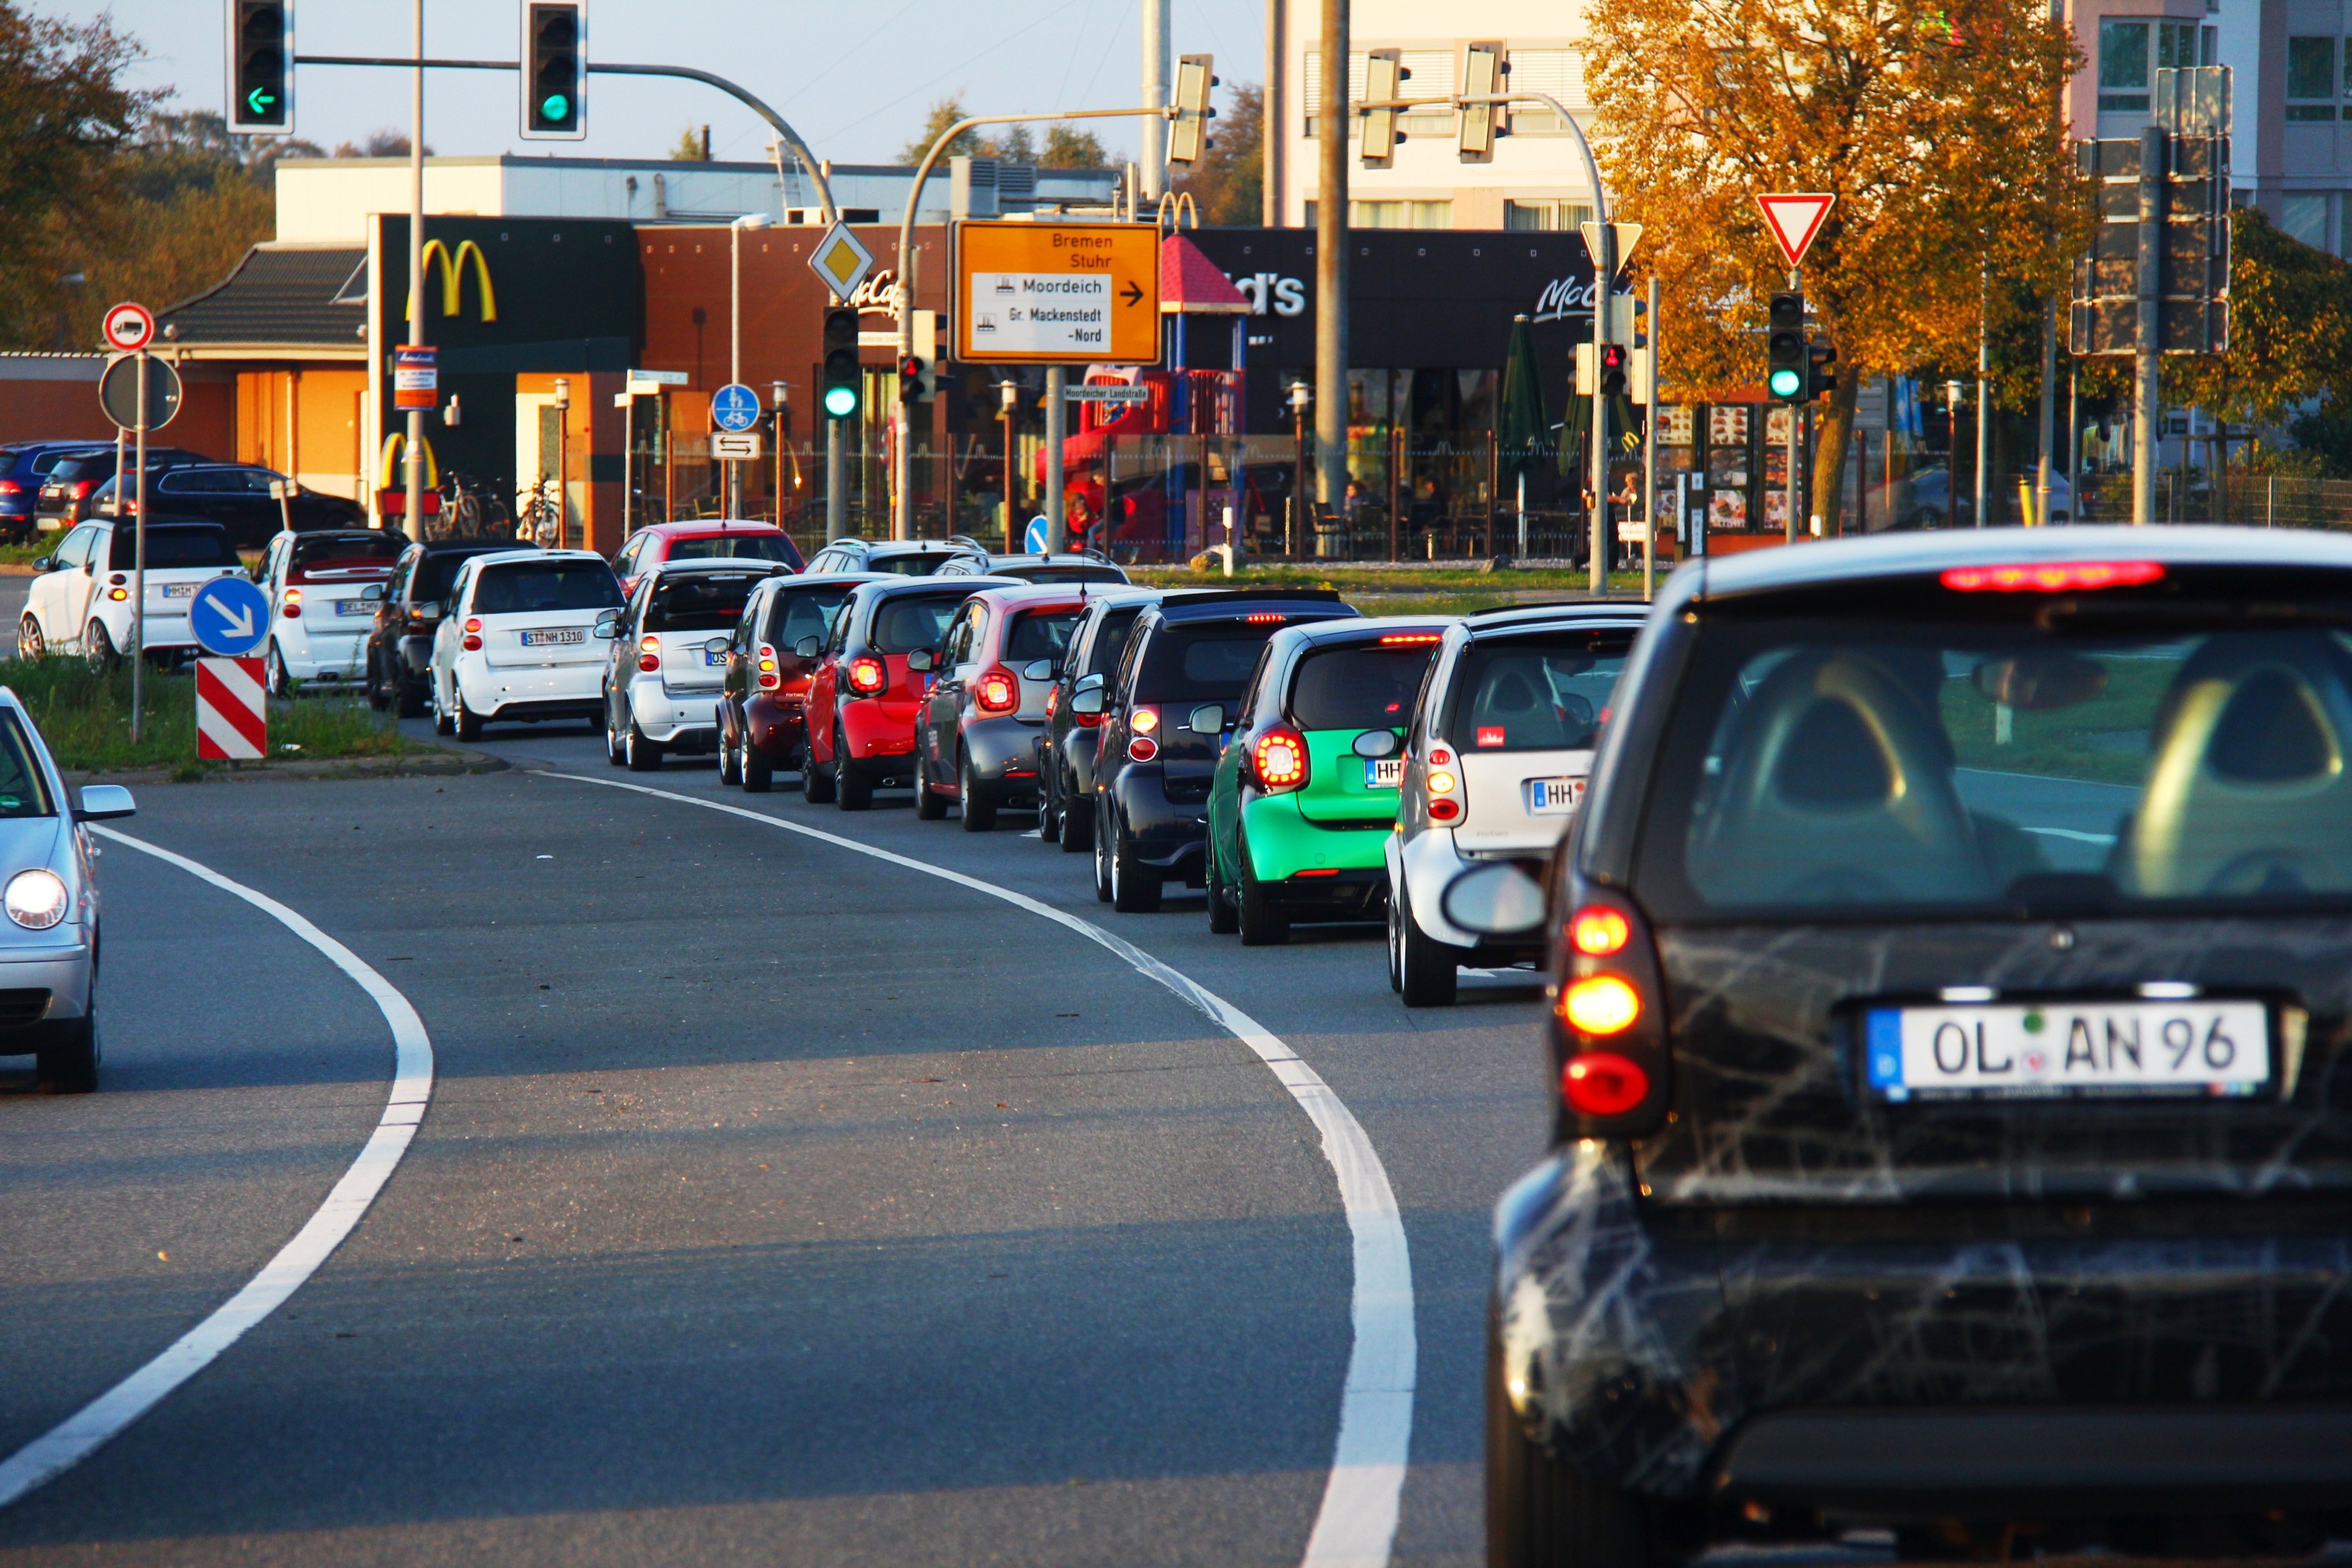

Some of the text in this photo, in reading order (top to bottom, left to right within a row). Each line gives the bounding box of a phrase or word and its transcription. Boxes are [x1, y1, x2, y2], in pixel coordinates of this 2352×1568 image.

[1053, 234, 1113, 249] Bremen
[1070, 254, 1112, 268] Stuhr
[1022, 279, 1102, 293] Moordeich
[1009, 308, 1102, 322] Gr. Mackenstedt
[1068, 329, 1102, 342] -Nord
[1066, 388, 1146, 398] Moordeicher Landstraße
[528, 630, 583, 644] ST NH 1310
[1377, 763, 1400, 779] HH
[1548, 784, 1572, 804] HH
[1933, 1021, 2013, 1075] OL
[2064, 1017, 2142, 1072] AN
[2161, 1017, 2237, 1072] 96
